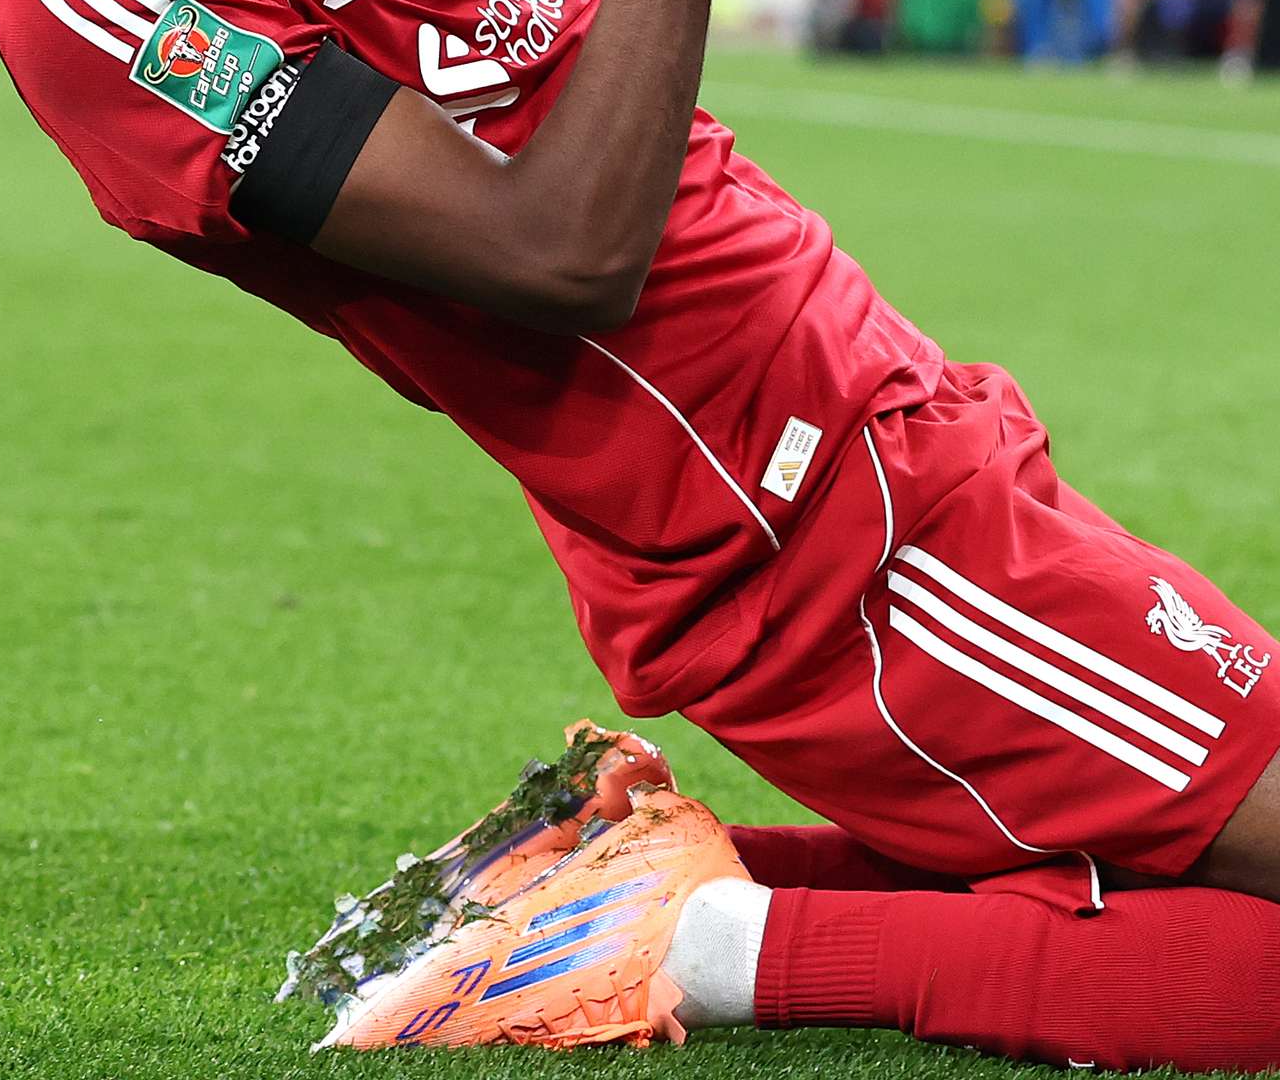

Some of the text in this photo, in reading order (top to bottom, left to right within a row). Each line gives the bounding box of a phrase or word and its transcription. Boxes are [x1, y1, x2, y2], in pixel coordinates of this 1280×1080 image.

[189, 27, 231, 111] Carabao
[212, 52, 240, 97] Cup
[238, 71, 254, 94] 10
[241, 64, 299, 127] room
[226, 134, 261, 174] for
